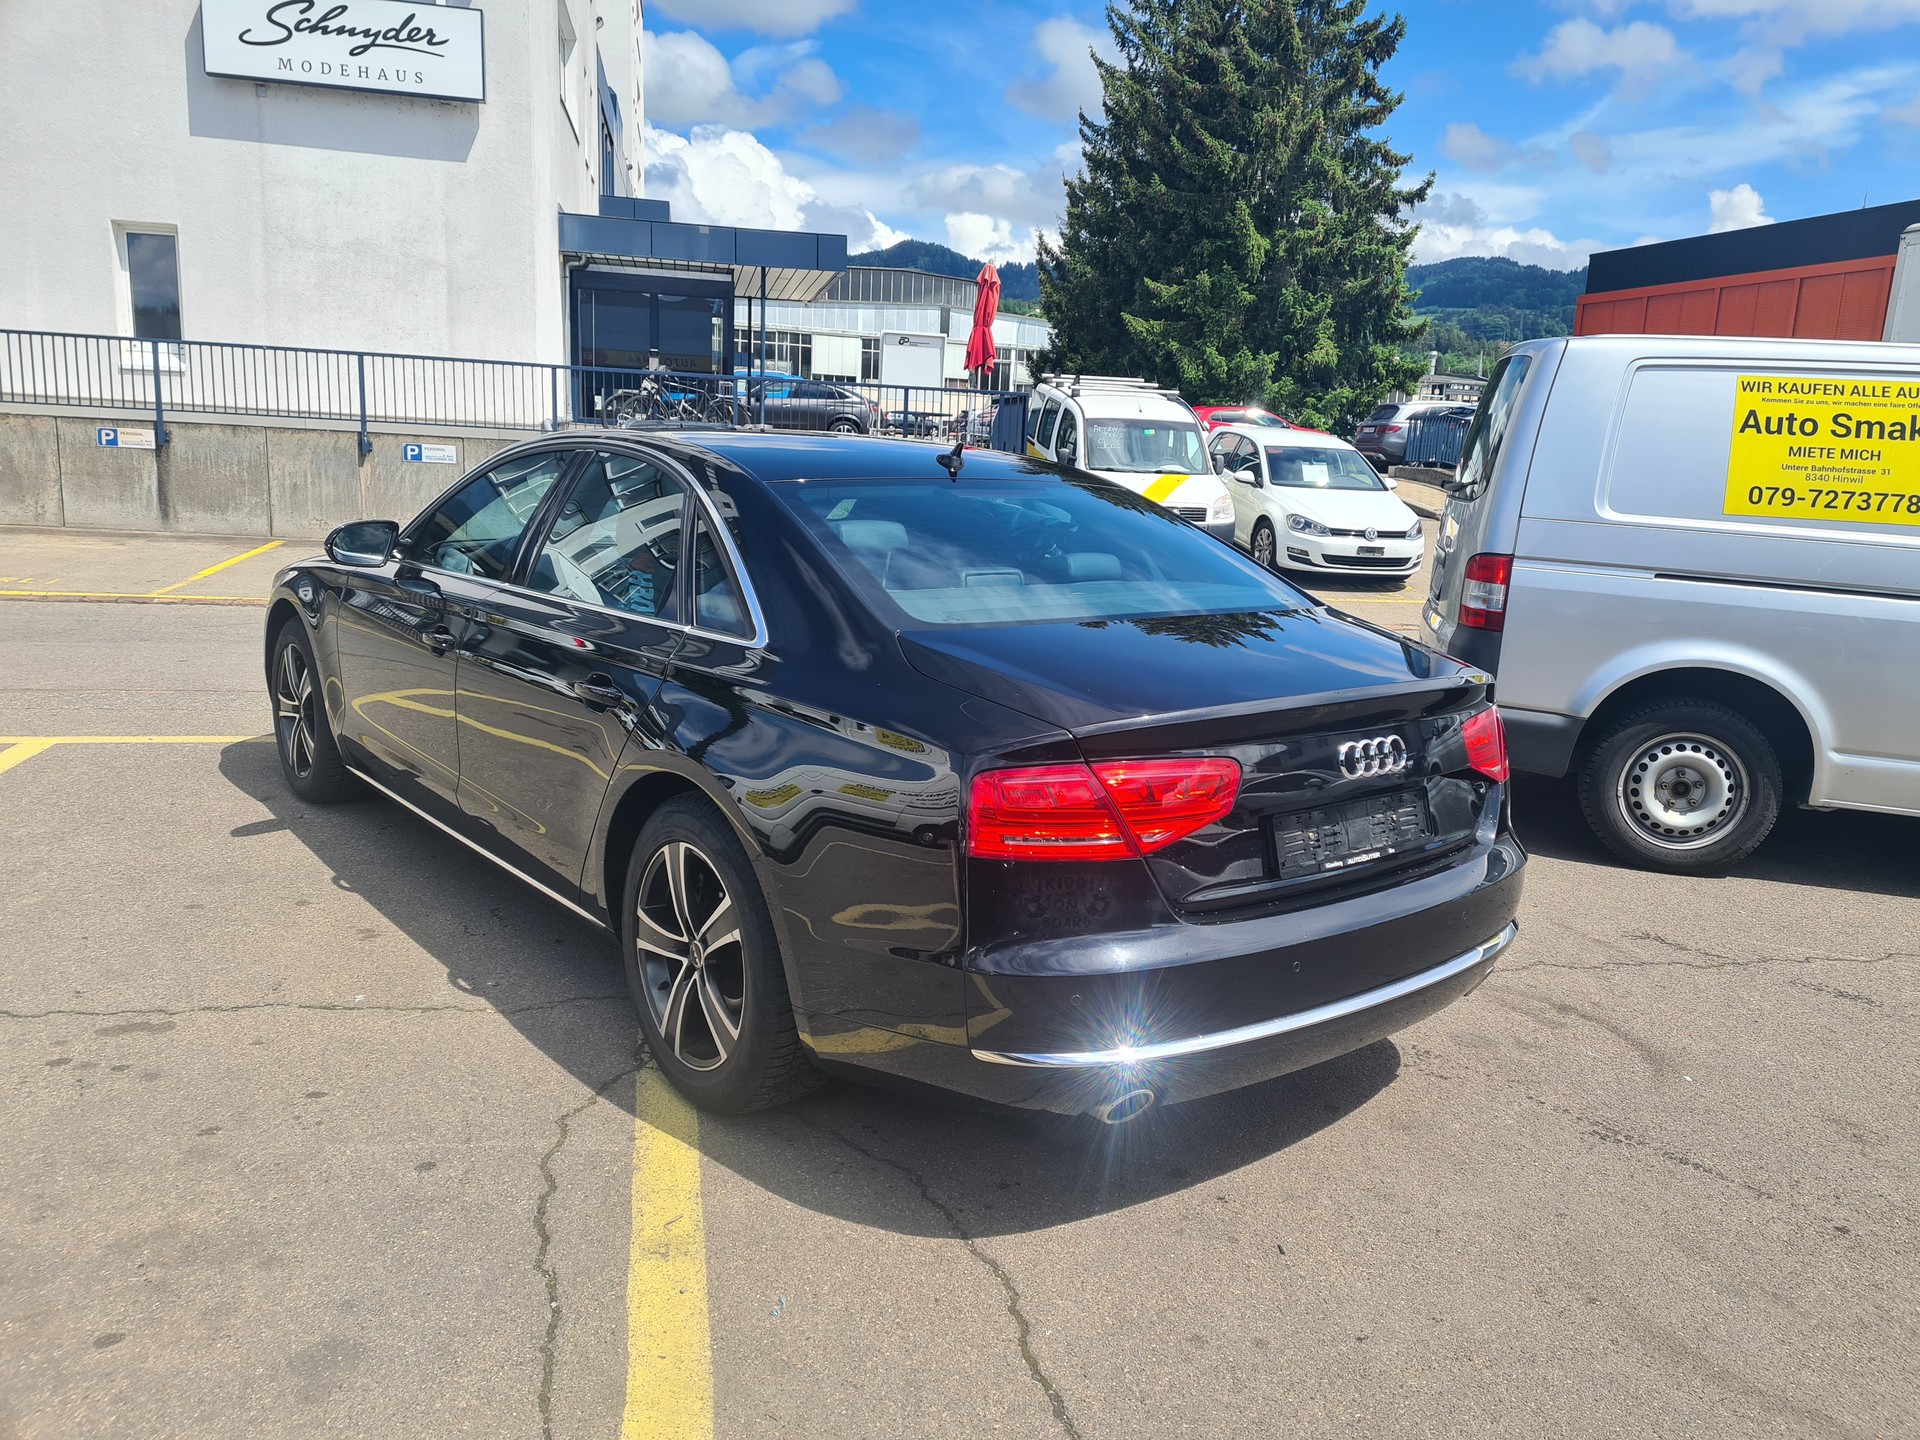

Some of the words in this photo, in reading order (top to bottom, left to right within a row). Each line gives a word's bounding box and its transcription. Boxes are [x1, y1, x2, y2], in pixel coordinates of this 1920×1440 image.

[238, 0, 450, 57] Schnyder
[277, 57, 425, 84] MODEHAUS
[1741, 380, 1772, 393] WIR
[1778, 382, 1845, 396] KAUFEN
[1850, 385, 1892, 398] ALLE
[1738, 409, 1819, 437] Auto
[101, 429, 115, 446] P
[406, 445, 420, 461] P
[1788, 446, 1836, 459] MIETE
[1840, 448, 1882, 461] MICH
[1781, 463, 1809, 472] Untere
[1811, 464, 1877, 475] Bahnhofstrasse
[1805, 473, 1830, 482] 8340
[1832, 474, 1864, 484] Hinwil
[1748, 486, 1920, 514] 079-7273778
